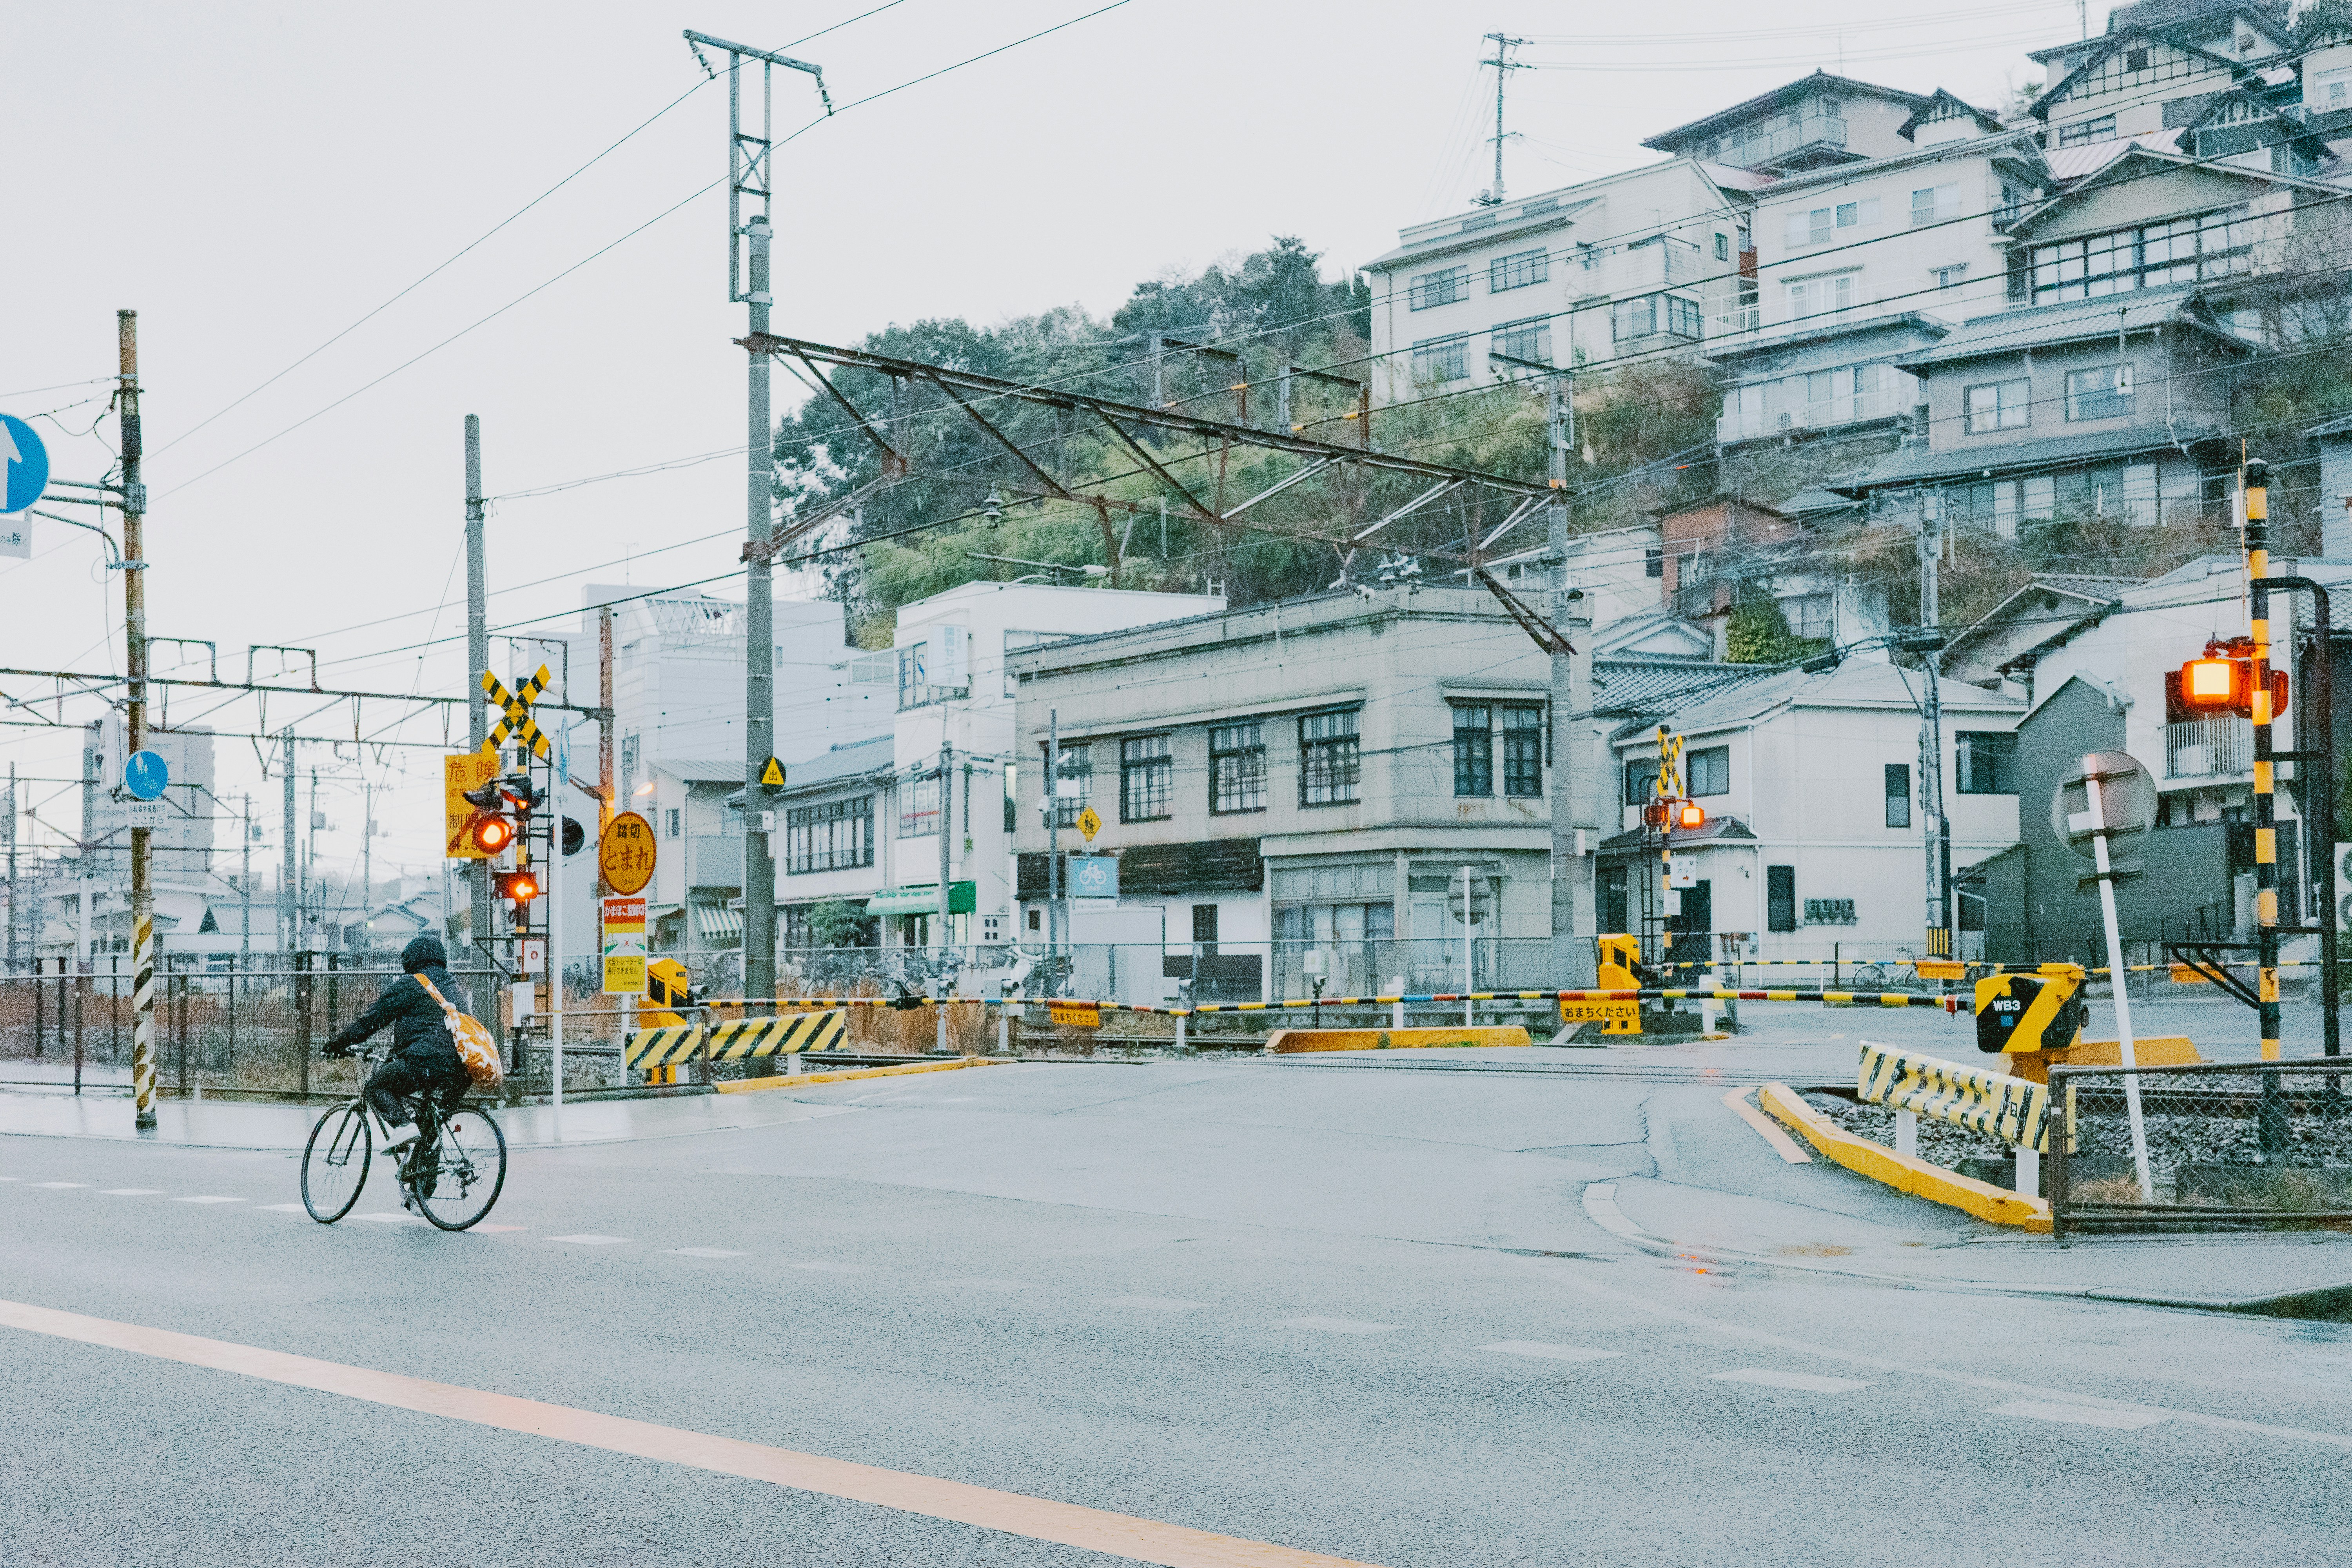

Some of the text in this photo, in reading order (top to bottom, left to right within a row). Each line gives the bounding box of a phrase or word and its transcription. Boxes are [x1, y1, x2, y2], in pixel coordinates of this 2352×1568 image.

[449, 760, 495, 782] 危険
[768, 769, 778, 780] 出
[132, 815, 164, 825] ここから
[617, 823, 640, 838] 踏切
[604, 845, 651, 871] とまれ
[1993, 1000, 2020, 1011] WB3
[1565, 1006, 1636, 1018] おまちください
